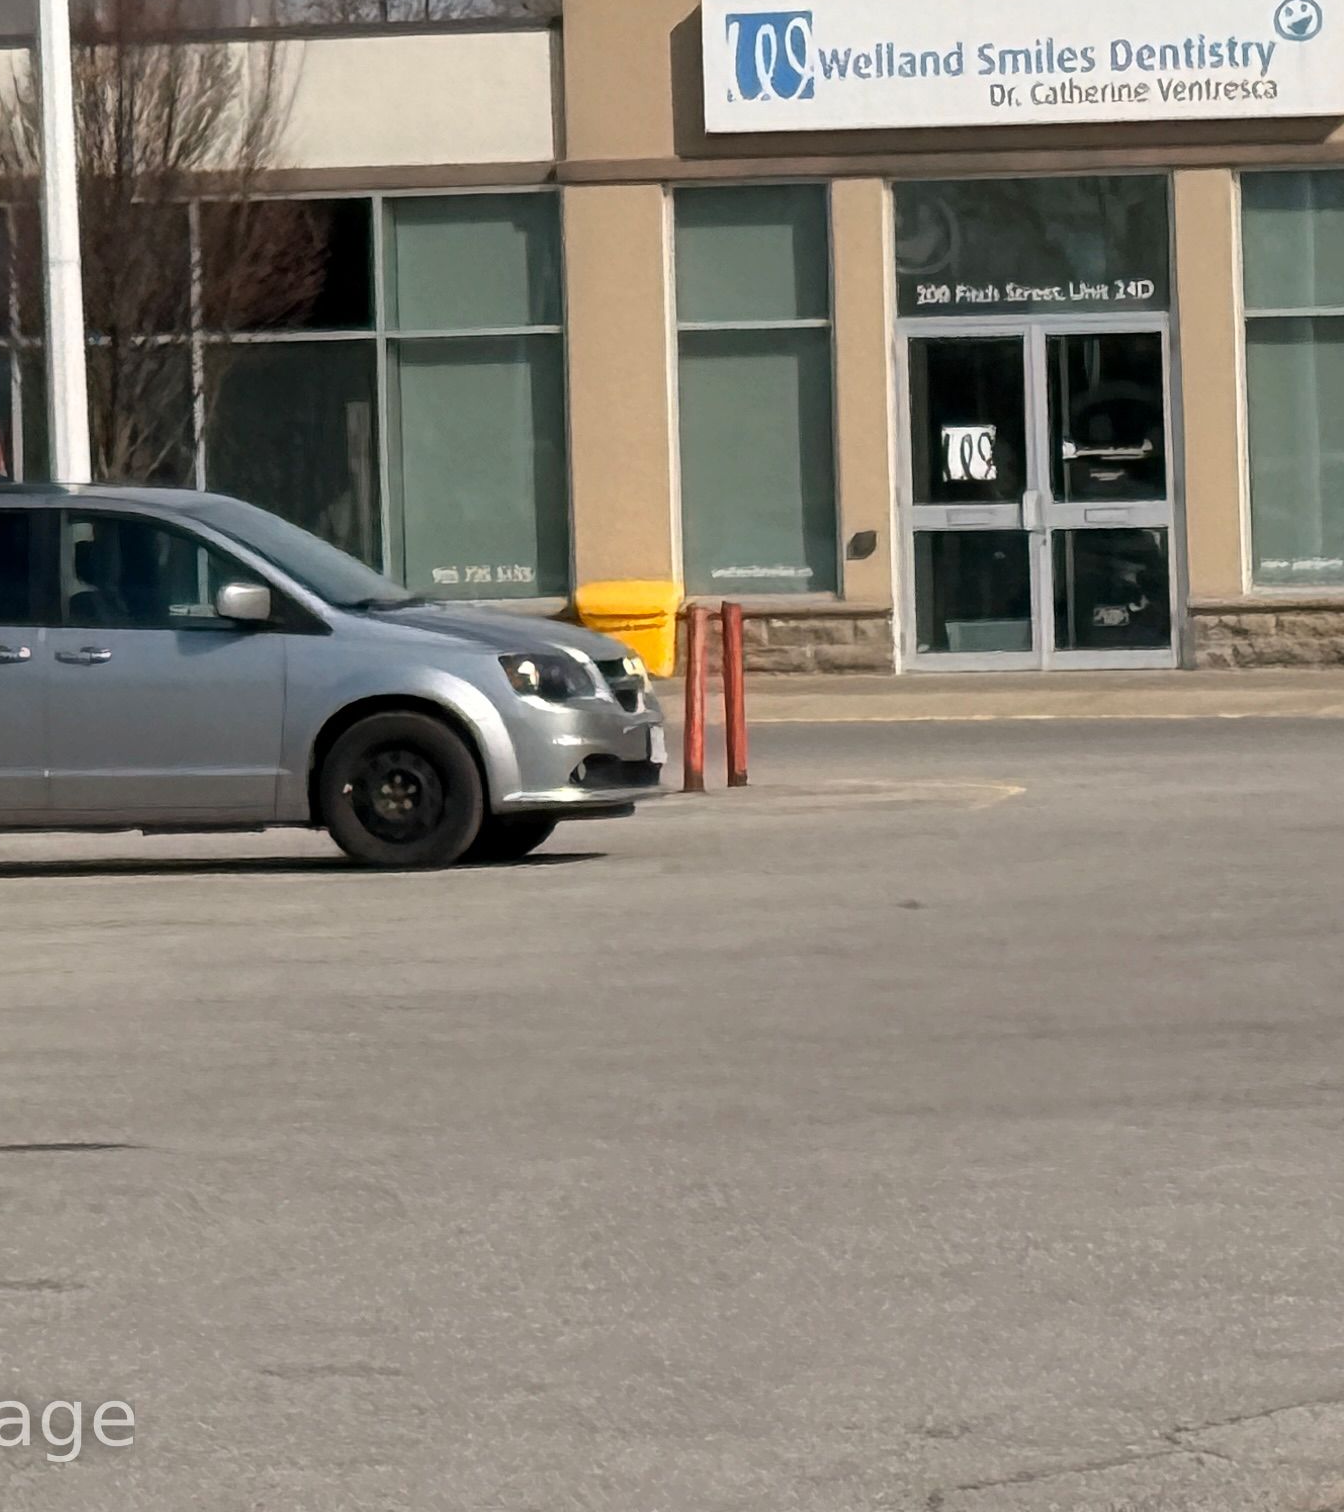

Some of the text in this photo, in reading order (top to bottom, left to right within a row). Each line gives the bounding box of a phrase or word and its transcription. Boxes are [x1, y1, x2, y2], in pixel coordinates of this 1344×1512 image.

[818, 34, 1276, 80] Welland Smiles Dentistry
[989, 77, 1278, 107] Dr. Catherine Ventresca
